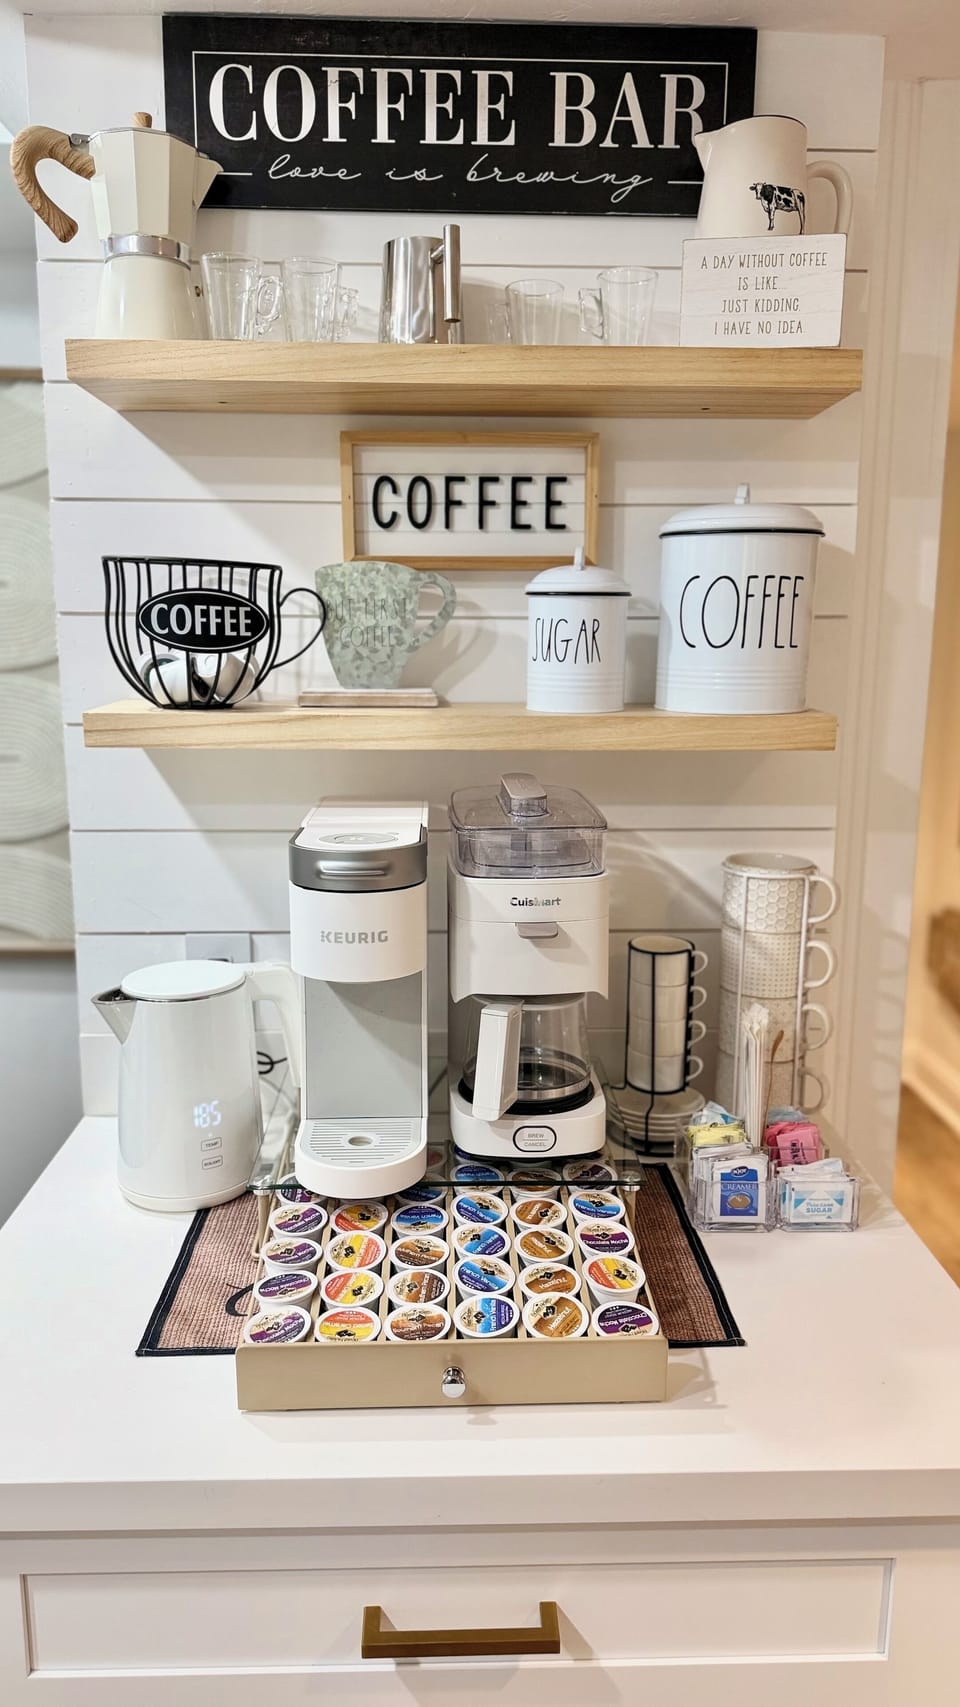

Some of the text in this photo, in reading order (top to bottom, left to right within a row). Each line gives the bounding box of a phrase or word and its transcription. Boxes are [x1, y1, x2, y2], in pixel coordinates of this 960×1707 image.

[208, 63, 707, 149] COFFEE BAR
[267, 153, 654, 202] love is brewing
[701, 252, 828, 270] A DAY WITHOUT COFFEE
[738, 276, 749, 291] IS
[721, 299, 748, 313] JUST
[714, 322, 718, 335] I
[723, 321, 751, 336] HAVE
[757, 321, 772, 335] NO
[372, 475, 568, 530] COFFEE
[150, 603, 253, 637] COFFEE
[326, 598, 352, 621] BUT
[679, 575, 805, 650] COFFEE
[341, 625, 396, 648] COFFEE
[532, 617, 602, 665] SUGAR
[510, 897, 562, 907] Cuisart
[320, 930, 389, 944] KEURIG
[193, 1100, 221, 1128] 185
[721, 1183, 757, 1191] CREAMER
